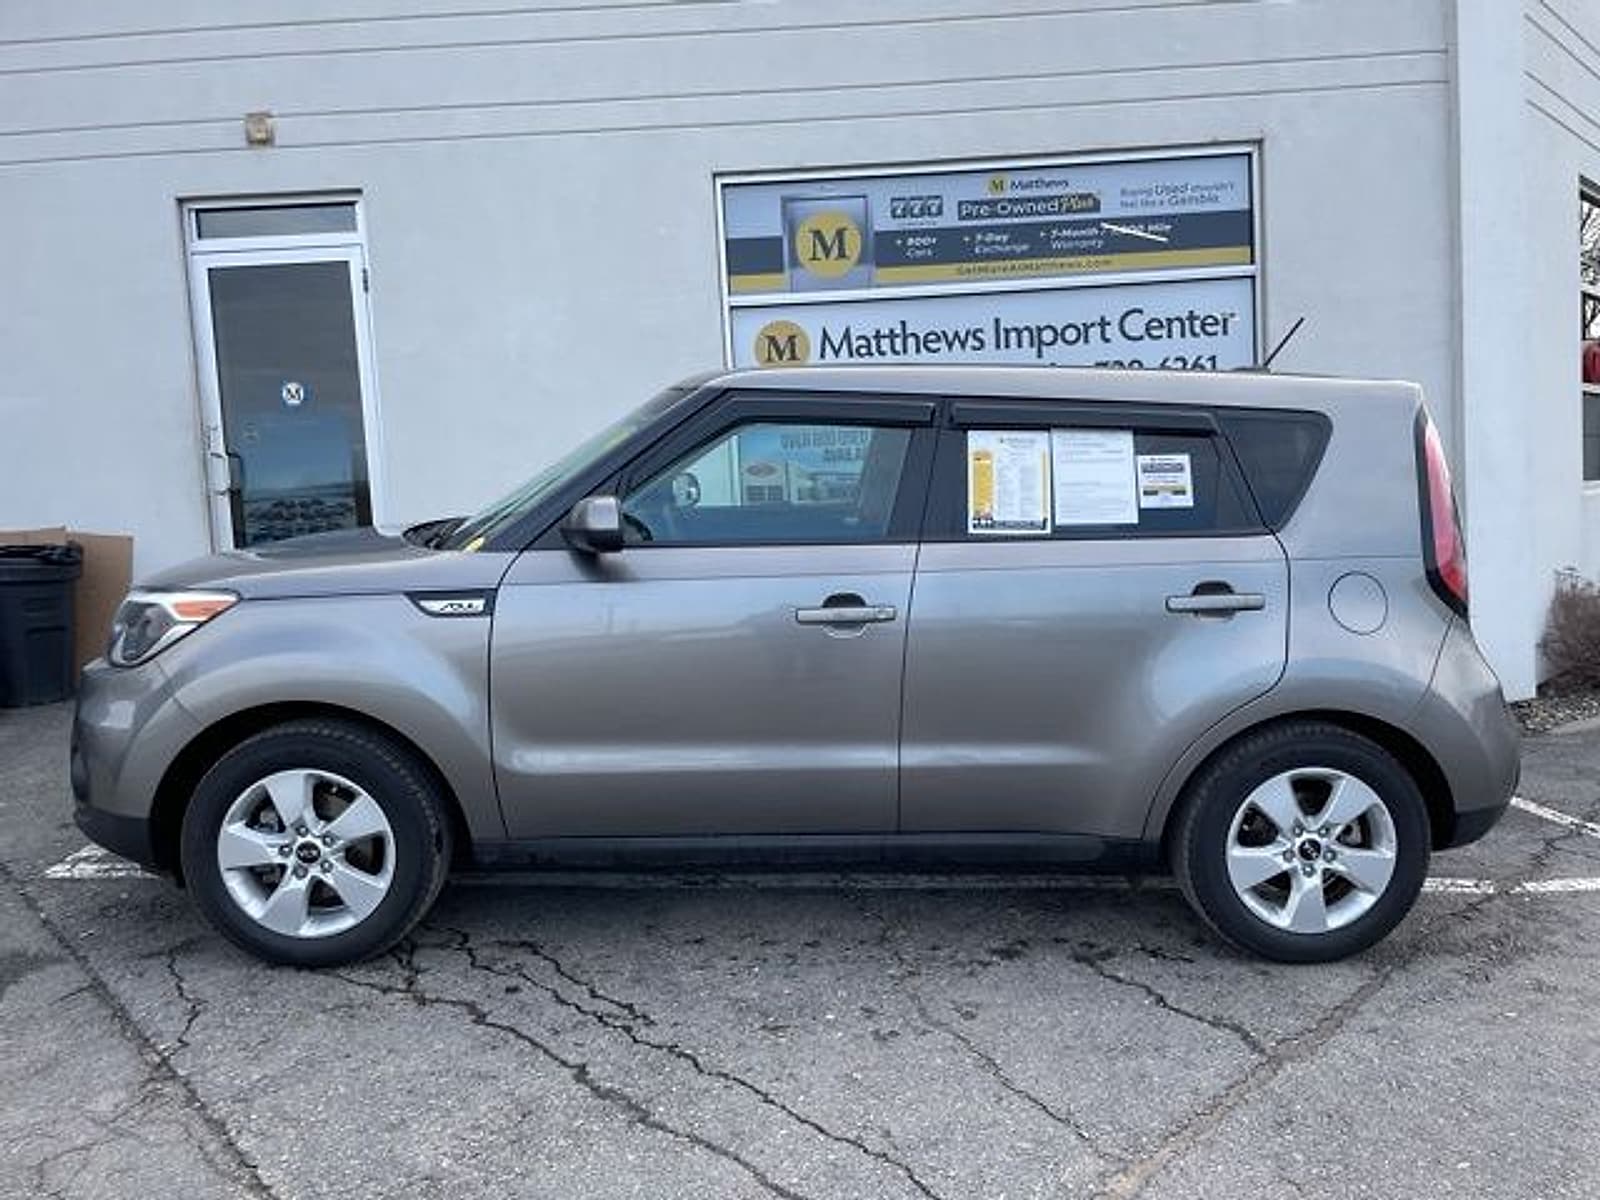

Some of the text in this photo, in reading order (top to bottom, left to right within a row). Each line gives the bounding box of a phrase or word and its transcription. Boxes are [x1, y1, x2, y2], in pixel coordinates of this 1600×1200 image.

[1010, 179, 1069, 191] Matthews
[961, 198, 1059, 218] Pre-Owned
[808, 228, 849, 262] M
[820, 307, 1230, 360] Matthews Import Center
[764, 335, 801, 362] M
